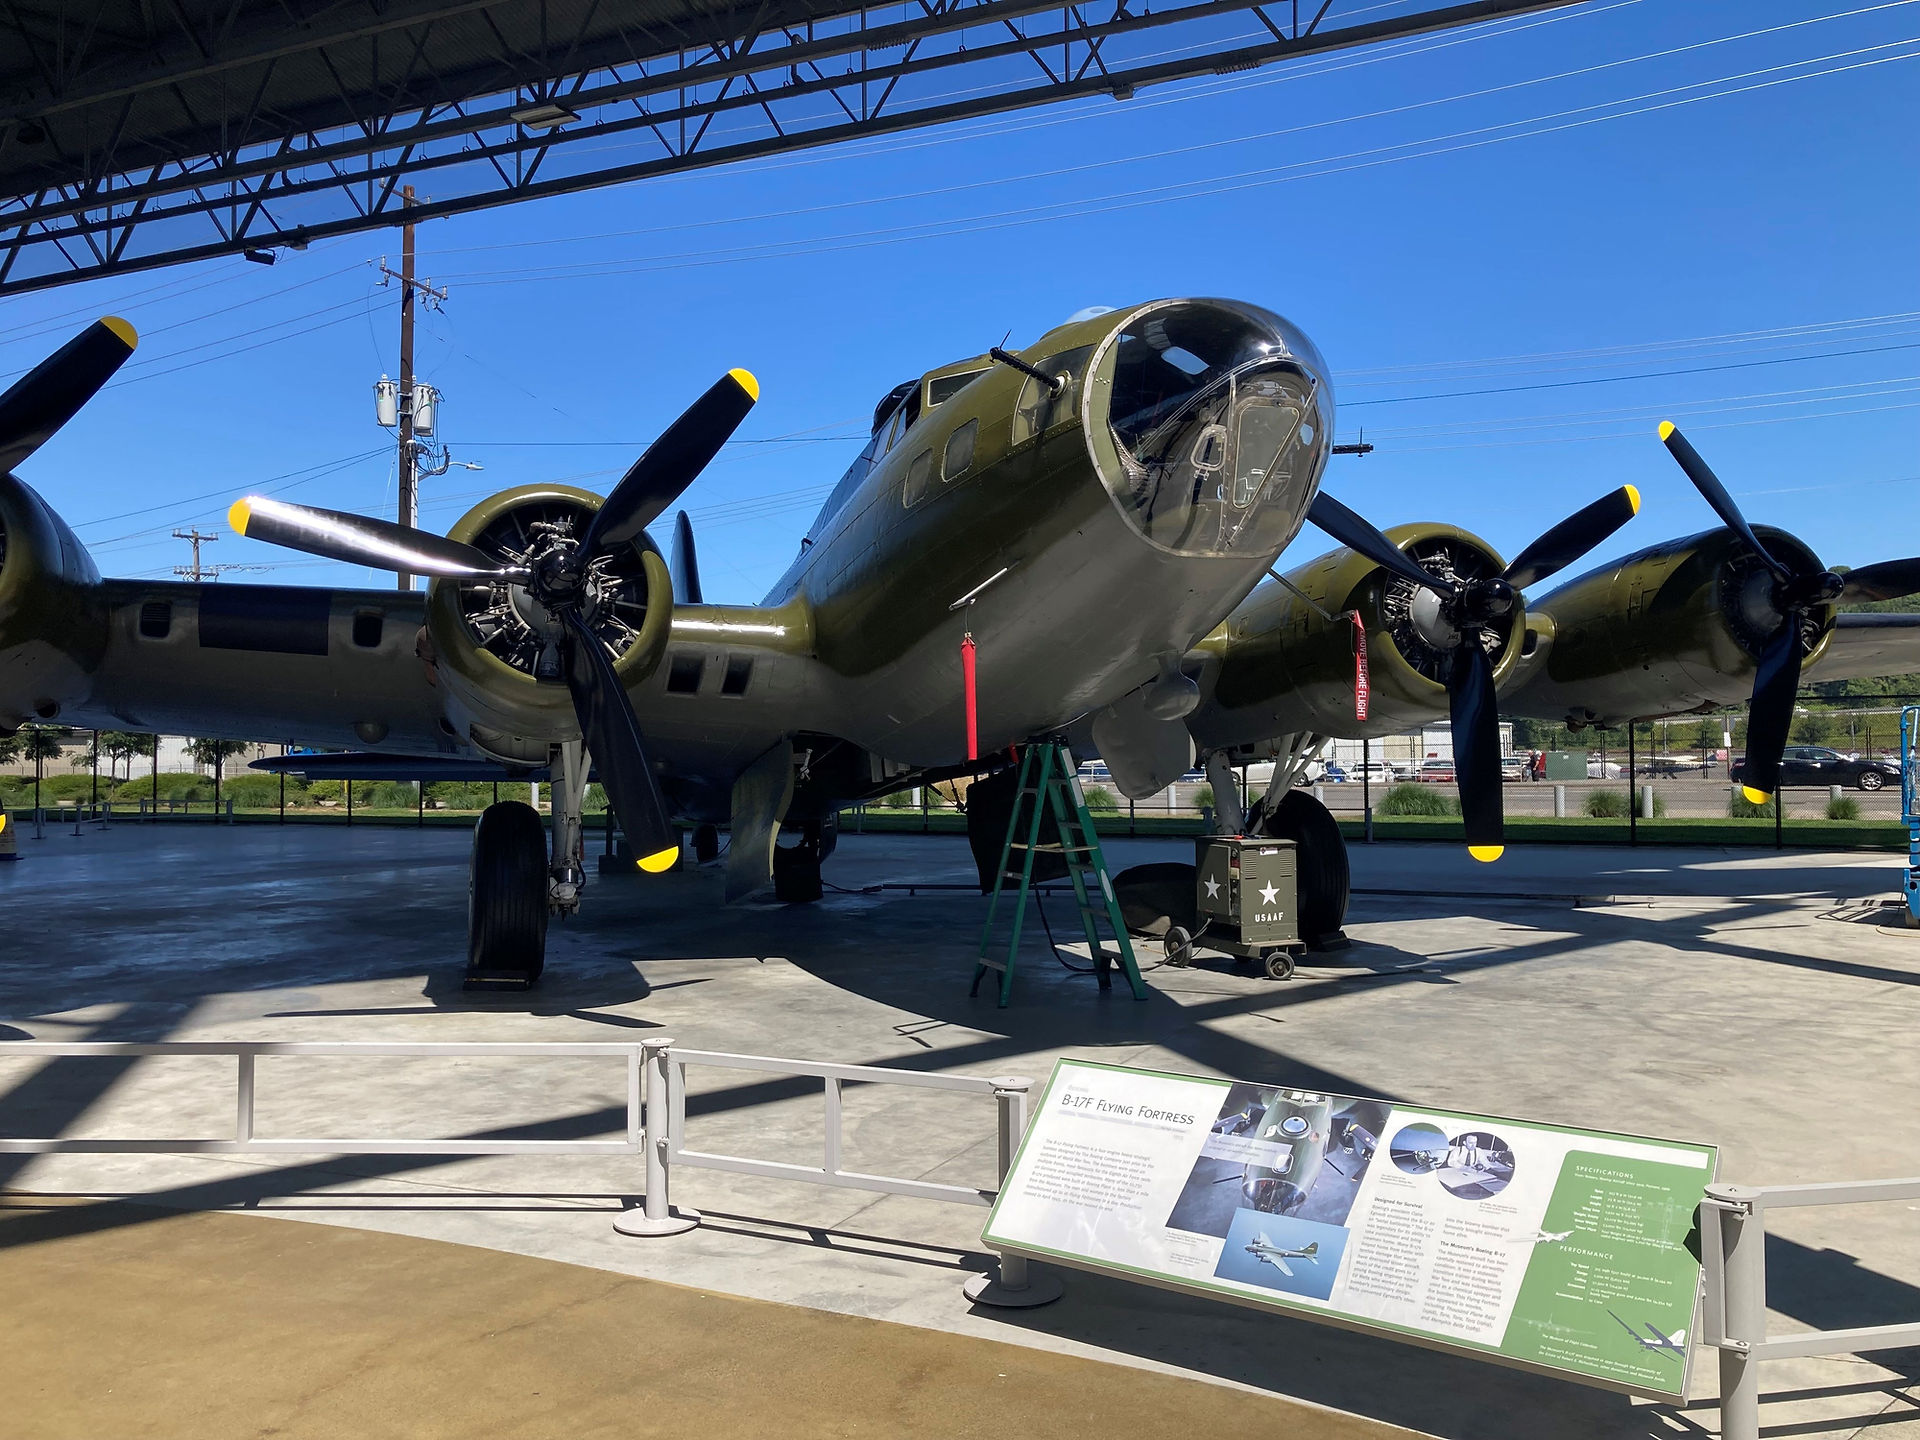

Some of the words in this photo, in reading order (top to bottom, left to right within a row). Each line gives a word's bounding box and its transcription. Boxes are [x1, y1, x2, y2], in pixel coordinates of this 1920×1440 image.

[1358, 658, 1368, 689] BEFORE
[1357, 690, 1367, 718] FLIGHT
[1255, 912, 1284, 923] USAAF
[1061, 1093, 1095, 1109] B-17F
[1096, 1099, 1134, 1116] FLYING
[1137, 1105, 1196, 1125] FORTRESS
[1575, 1165, 1634, 1179] SPECIFICATIONS
[1374, 1196, 1396, 1206] Designed
[1450, 1242, 1475, 1251] Museum's
[1475, 1247, 1493, 1256] Boeing
[1559, 1245, 1614, 1260] PERFORMANCE
